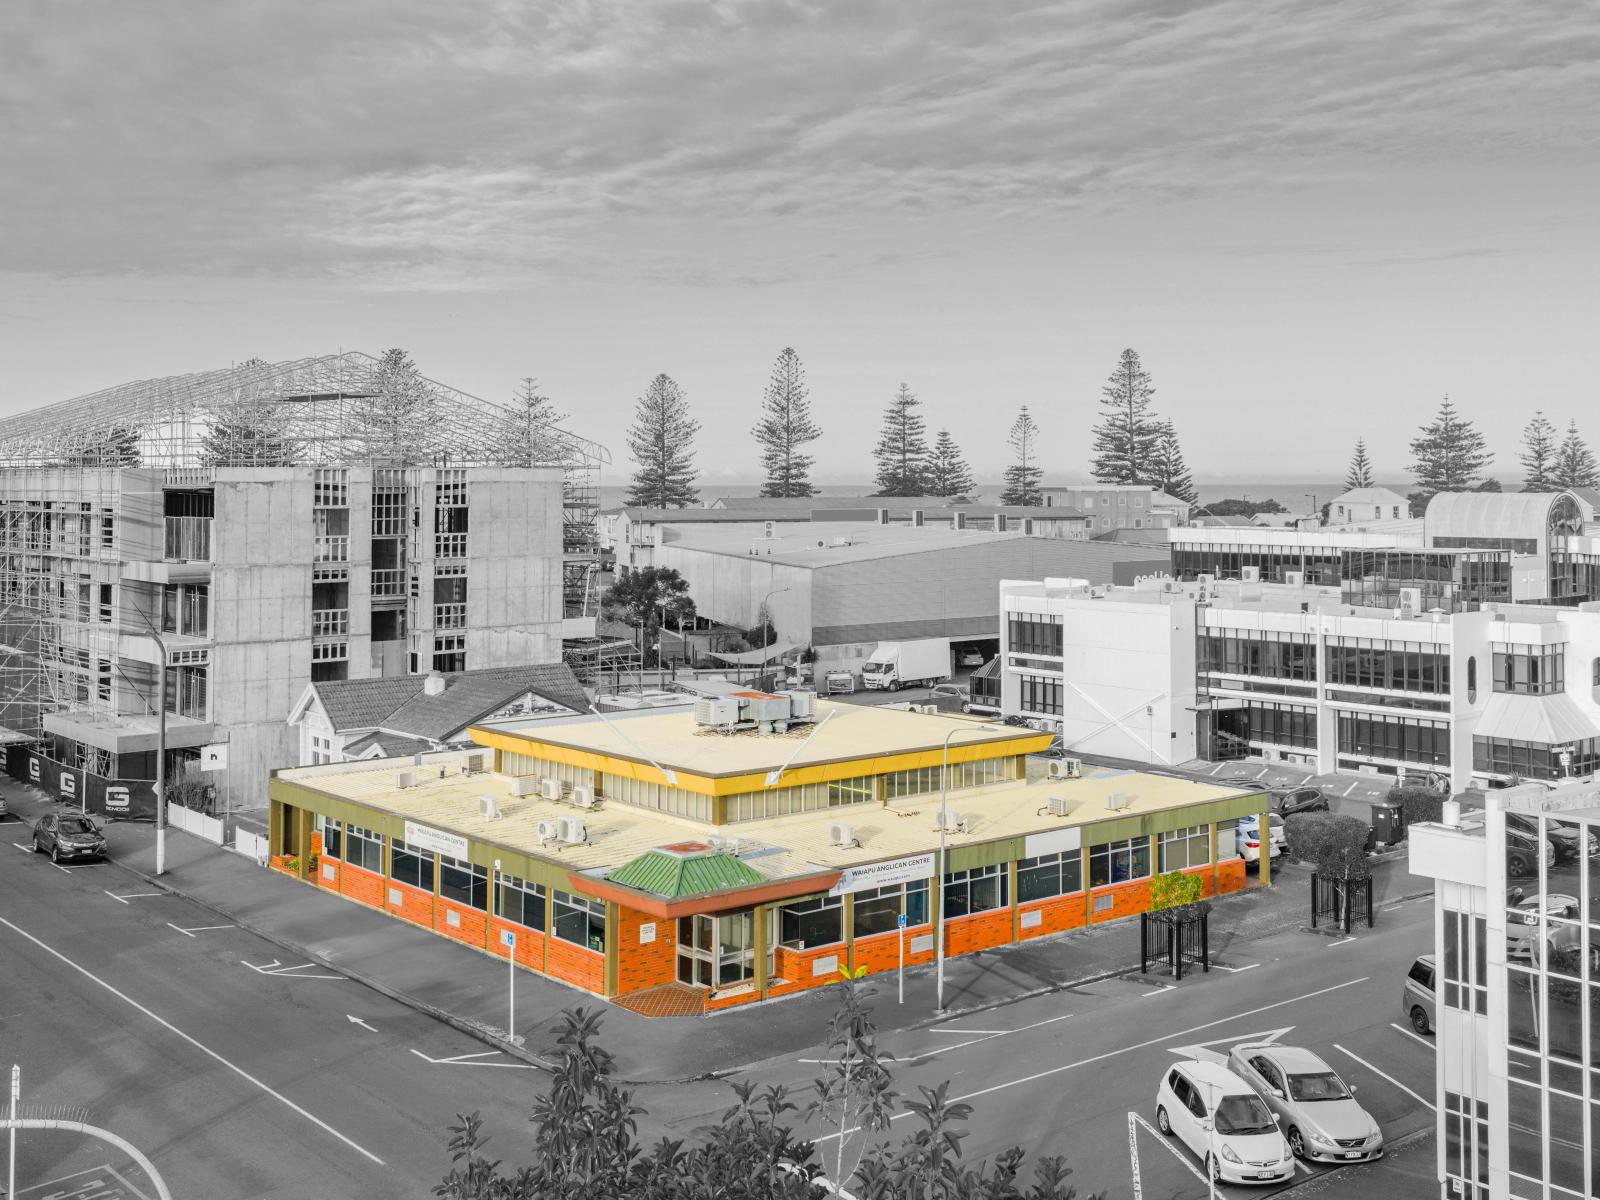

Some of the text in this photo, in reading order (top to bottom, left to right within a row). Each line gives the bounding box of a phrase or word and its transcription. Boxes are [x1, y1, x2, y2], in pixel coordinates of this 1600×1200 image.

[60, 771, 76, 793] G
[105, 786, 130, 806] G
[851, 866, 876, 877] WAIAPU
[877, 860, 907, 872] ANGLICAN
[908, 857, 930, 867] CENTRE
